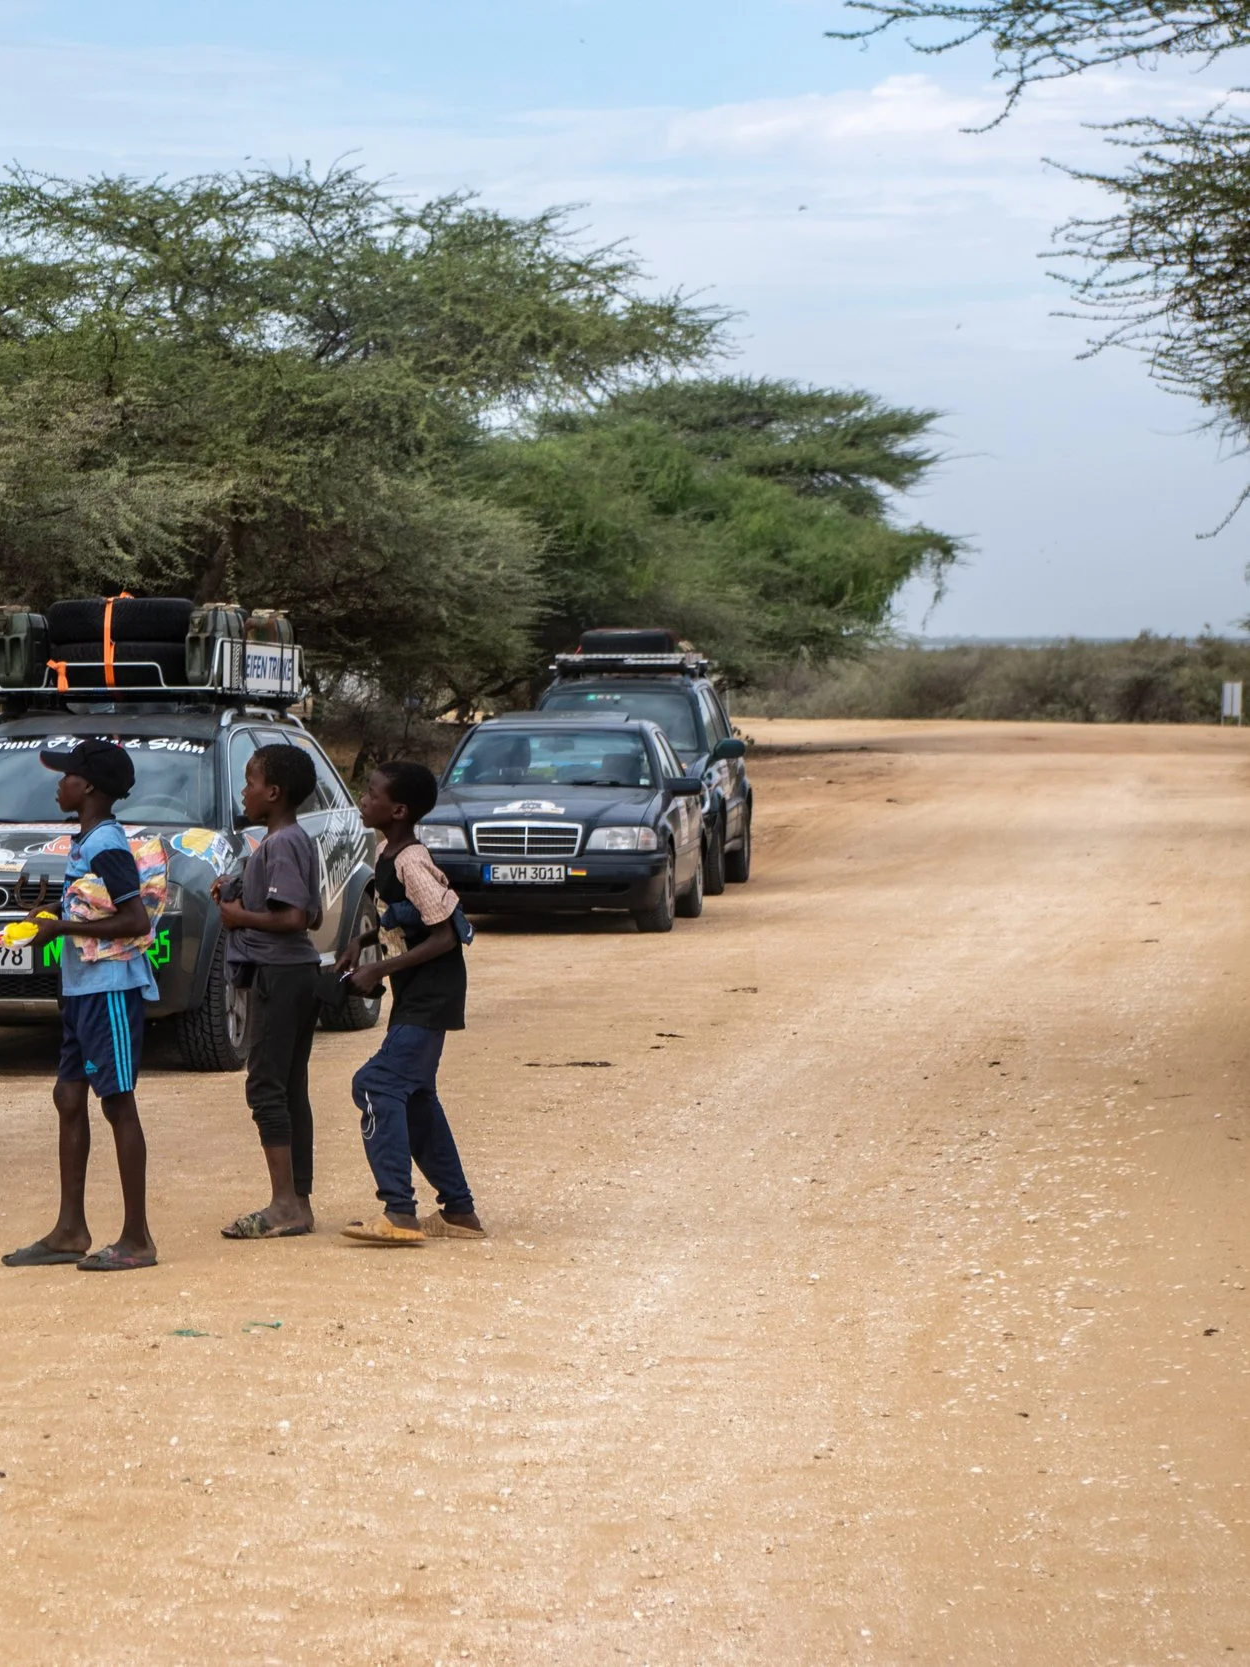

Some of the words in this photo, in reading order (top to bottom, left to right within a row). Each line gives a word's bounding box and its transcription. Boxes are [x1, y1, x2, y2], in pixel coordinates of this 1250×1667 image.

[244, 654, 267, 679] EIFEN
[492, 867, 500, 880] E
[509, 867, 527, 880] VH
[530, 867, 564, 881] 3011
